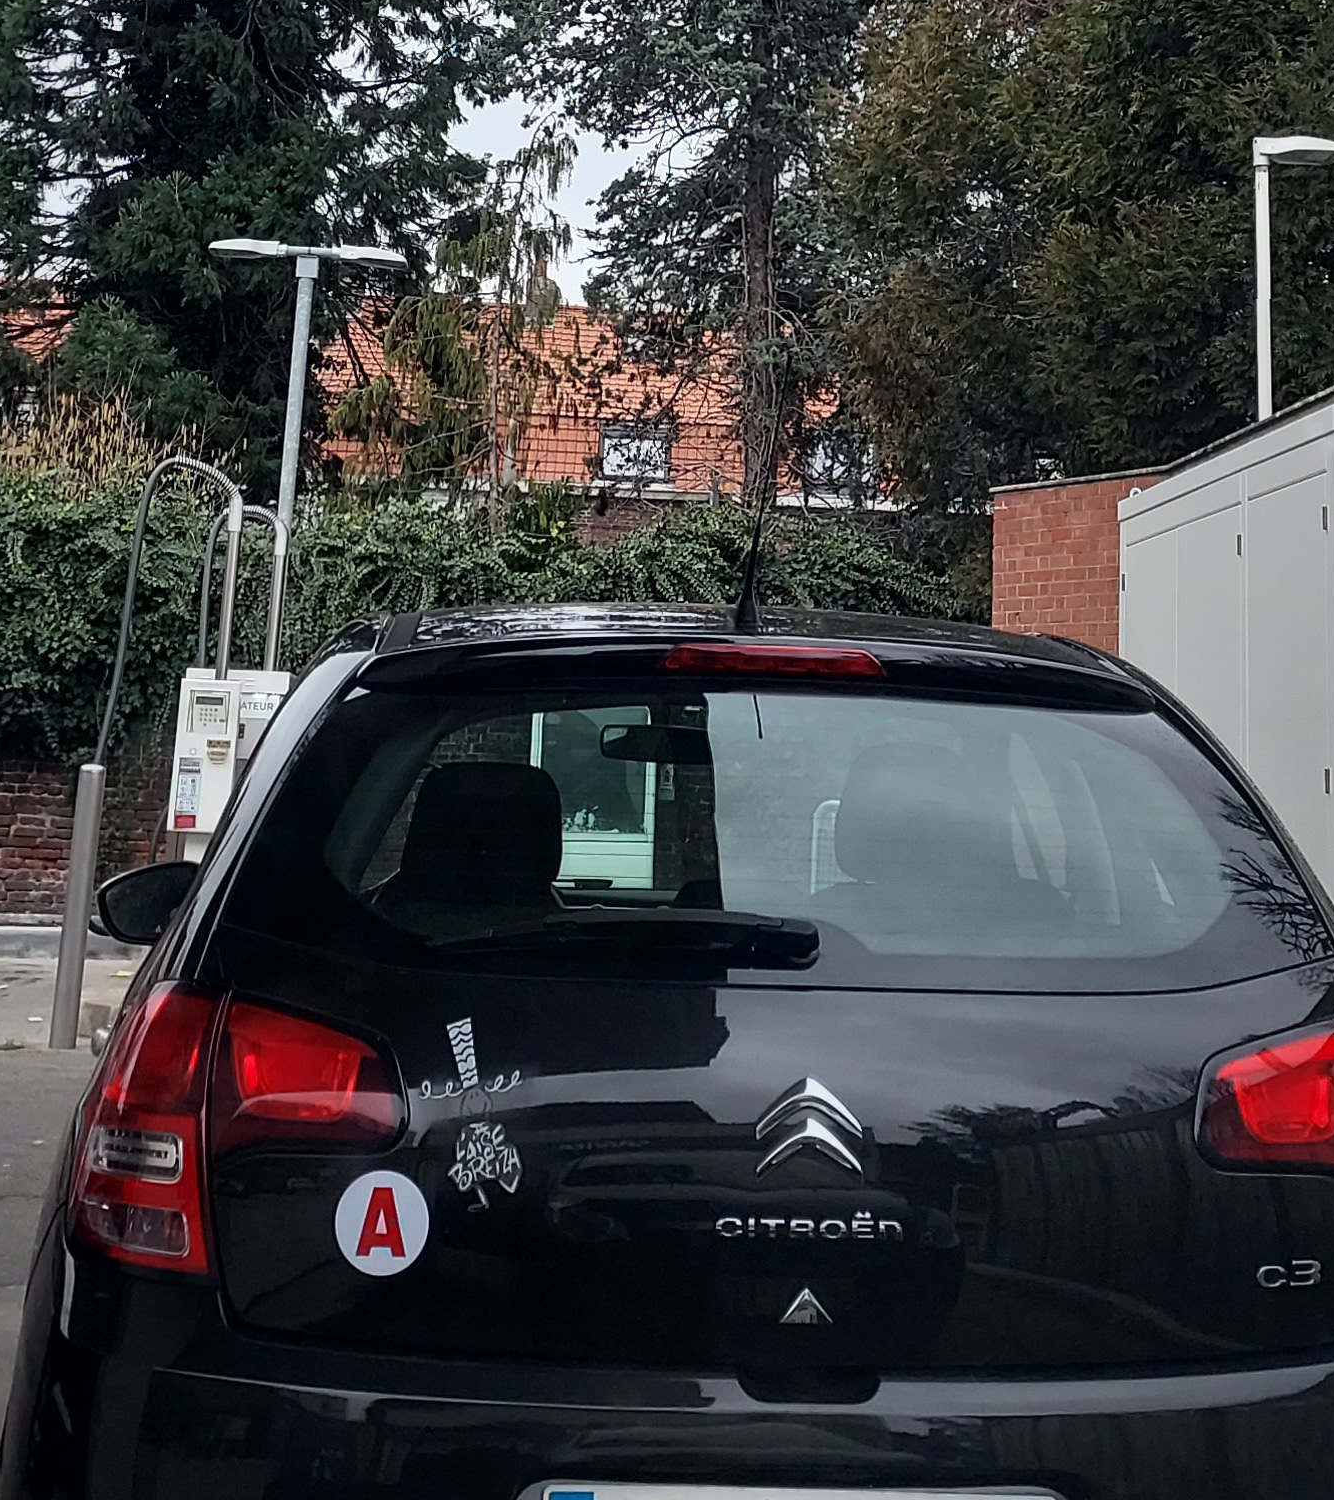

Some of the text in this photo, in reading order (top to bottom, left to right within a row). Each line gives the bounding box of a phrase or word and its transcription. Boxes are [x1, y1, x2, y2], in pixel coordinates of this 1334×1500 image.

[447, 1148, 521, 1191] BREIZH
[356, 1186, 407, 1258] A
[715, 1211, 903, 1239] CITROËN
[1256, 1259, 1322, 1288] C3
